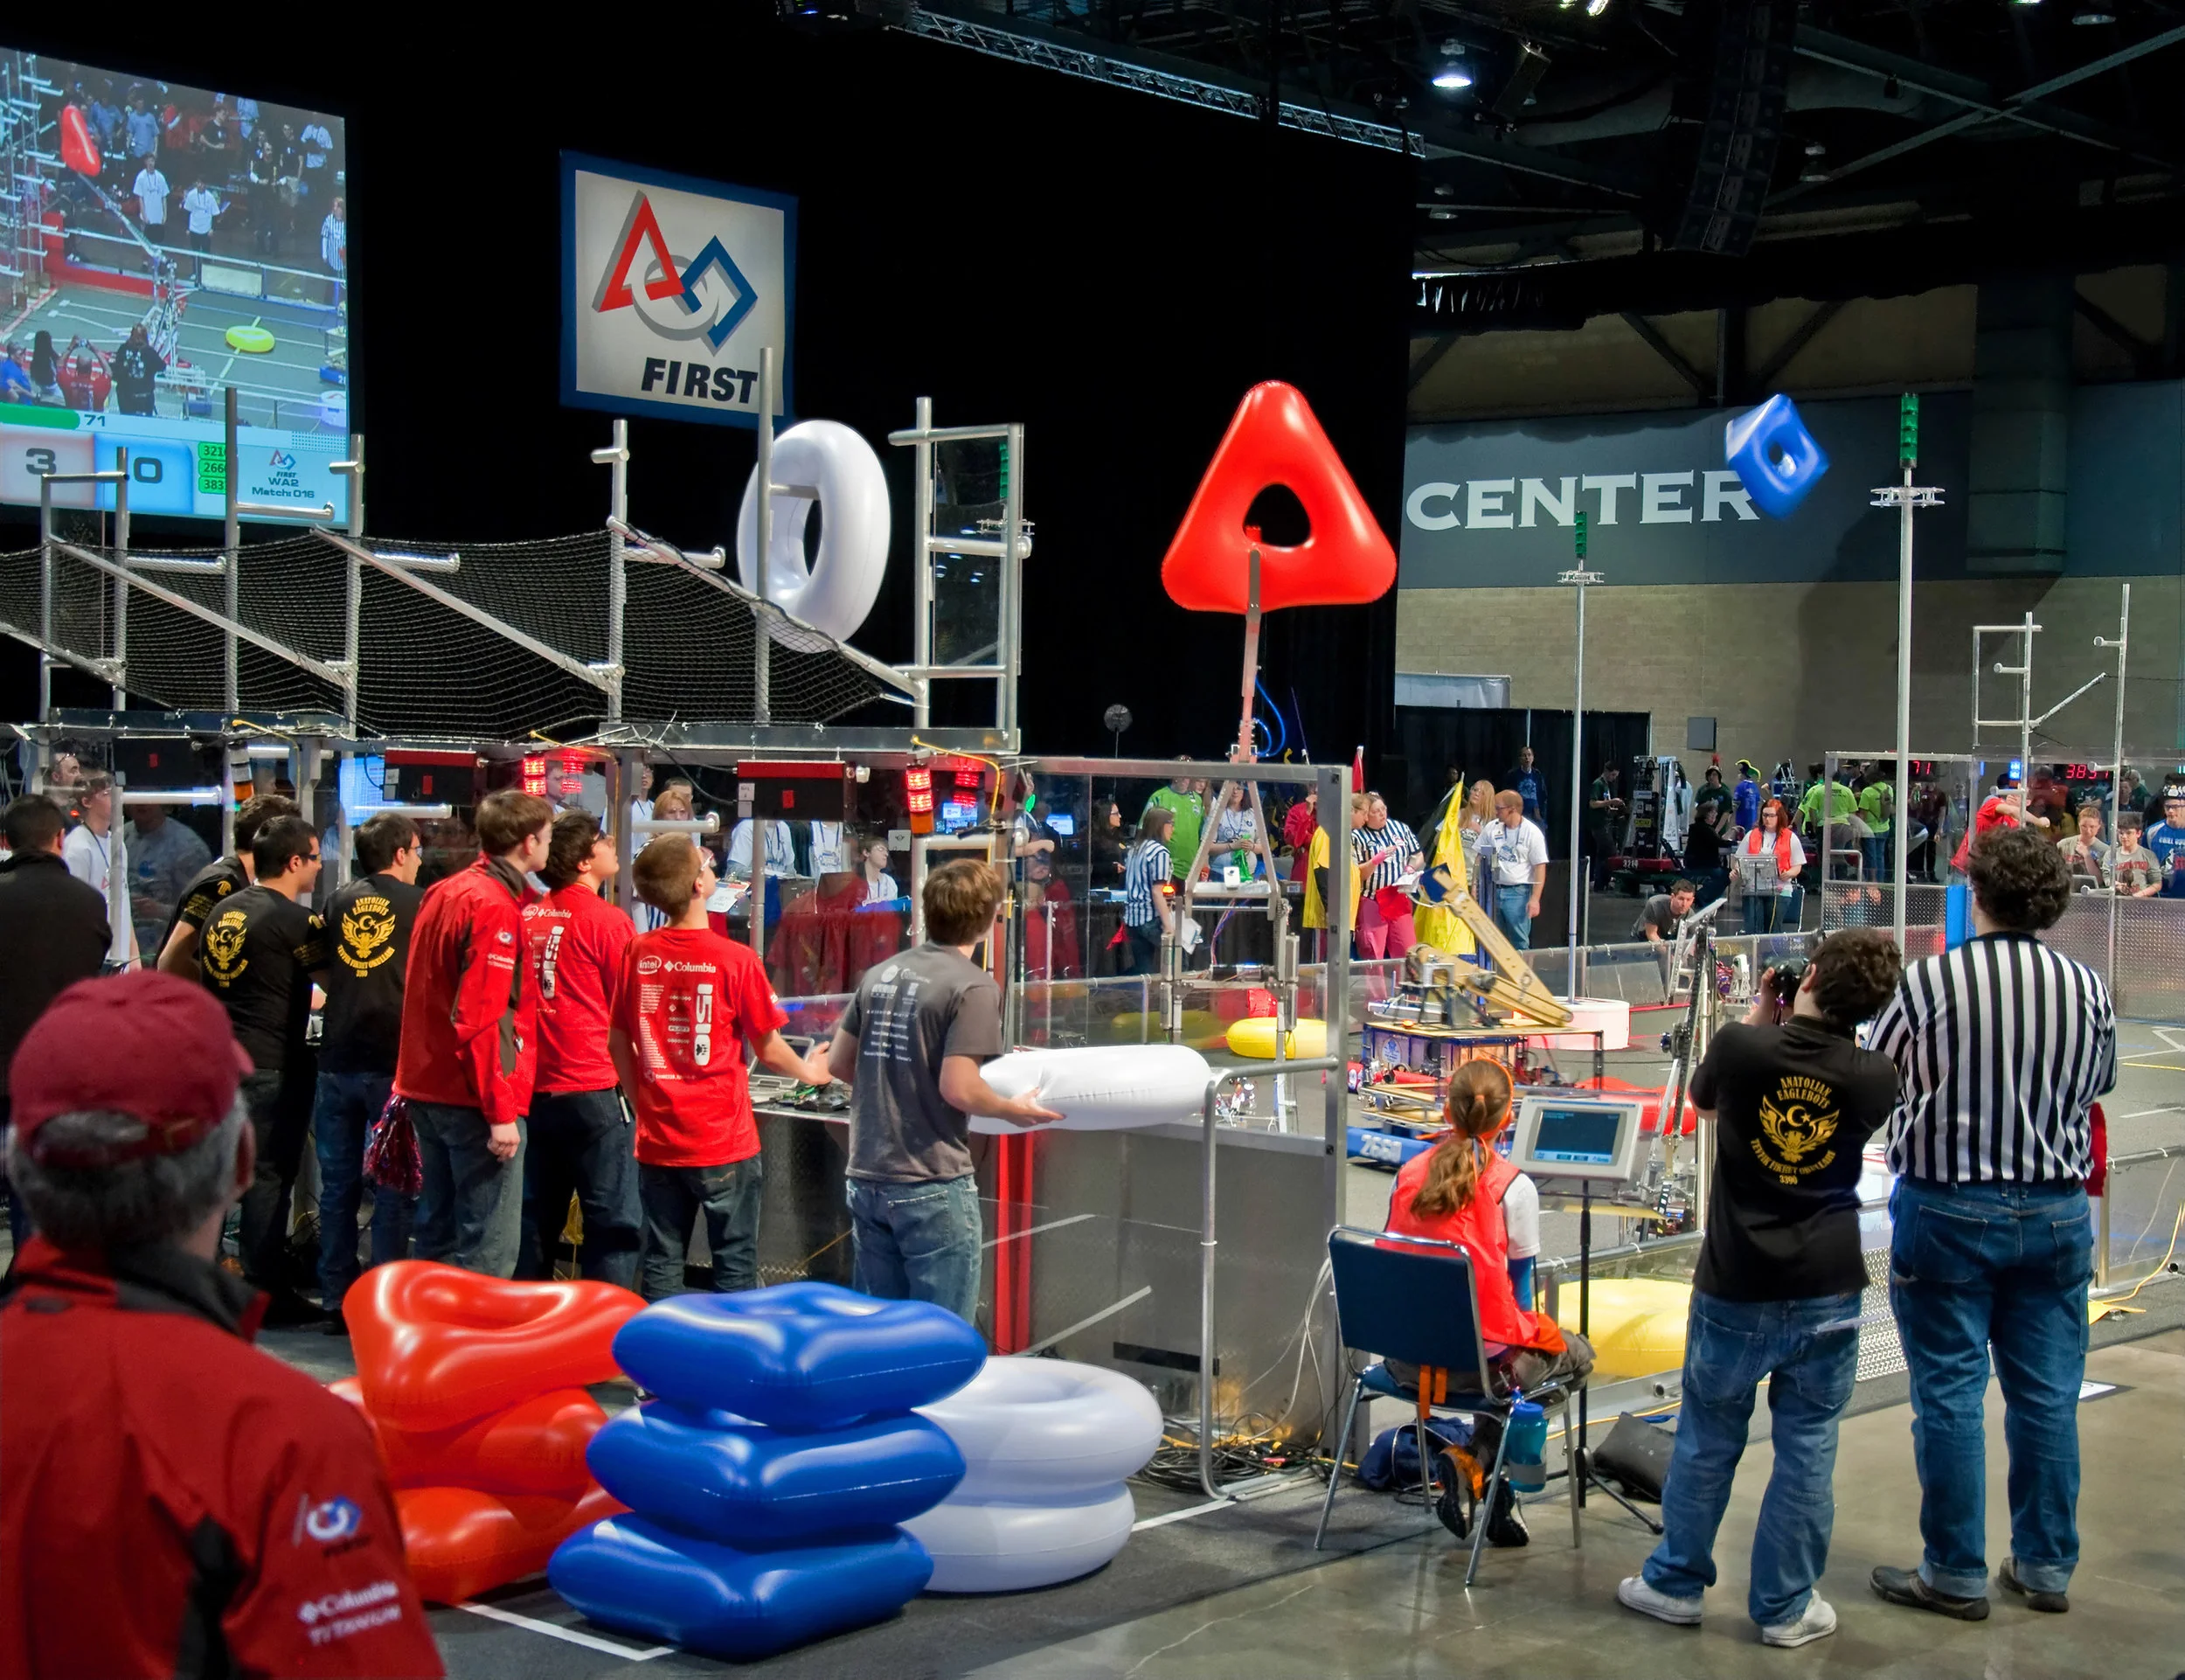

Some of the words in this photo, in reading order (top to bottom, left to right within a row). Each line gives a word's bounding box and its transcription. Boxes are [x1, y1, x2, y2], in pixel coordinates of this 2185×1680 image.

[641, 356, 759, 405] FIRST
[84, 414, 106, 427] 71
[204, 446, 225, 457] 321
[25, 448, 56, 476] 3
[204, 462, 225, 473] 266
[134, 456, 163, 483] 0
[204, 479, 225, 490] 383
[268, 477, 299, 487] WA2
[1405, 469, 1760, 531] CENTER
[1912, 760, 1932, 774] 71
[674, 961, 717, 973] Columbia
[1779, 1076, 1832, 1097] ANATOLIAN
[1776, 1087, 1831, 1109] EAGLEBOTS
